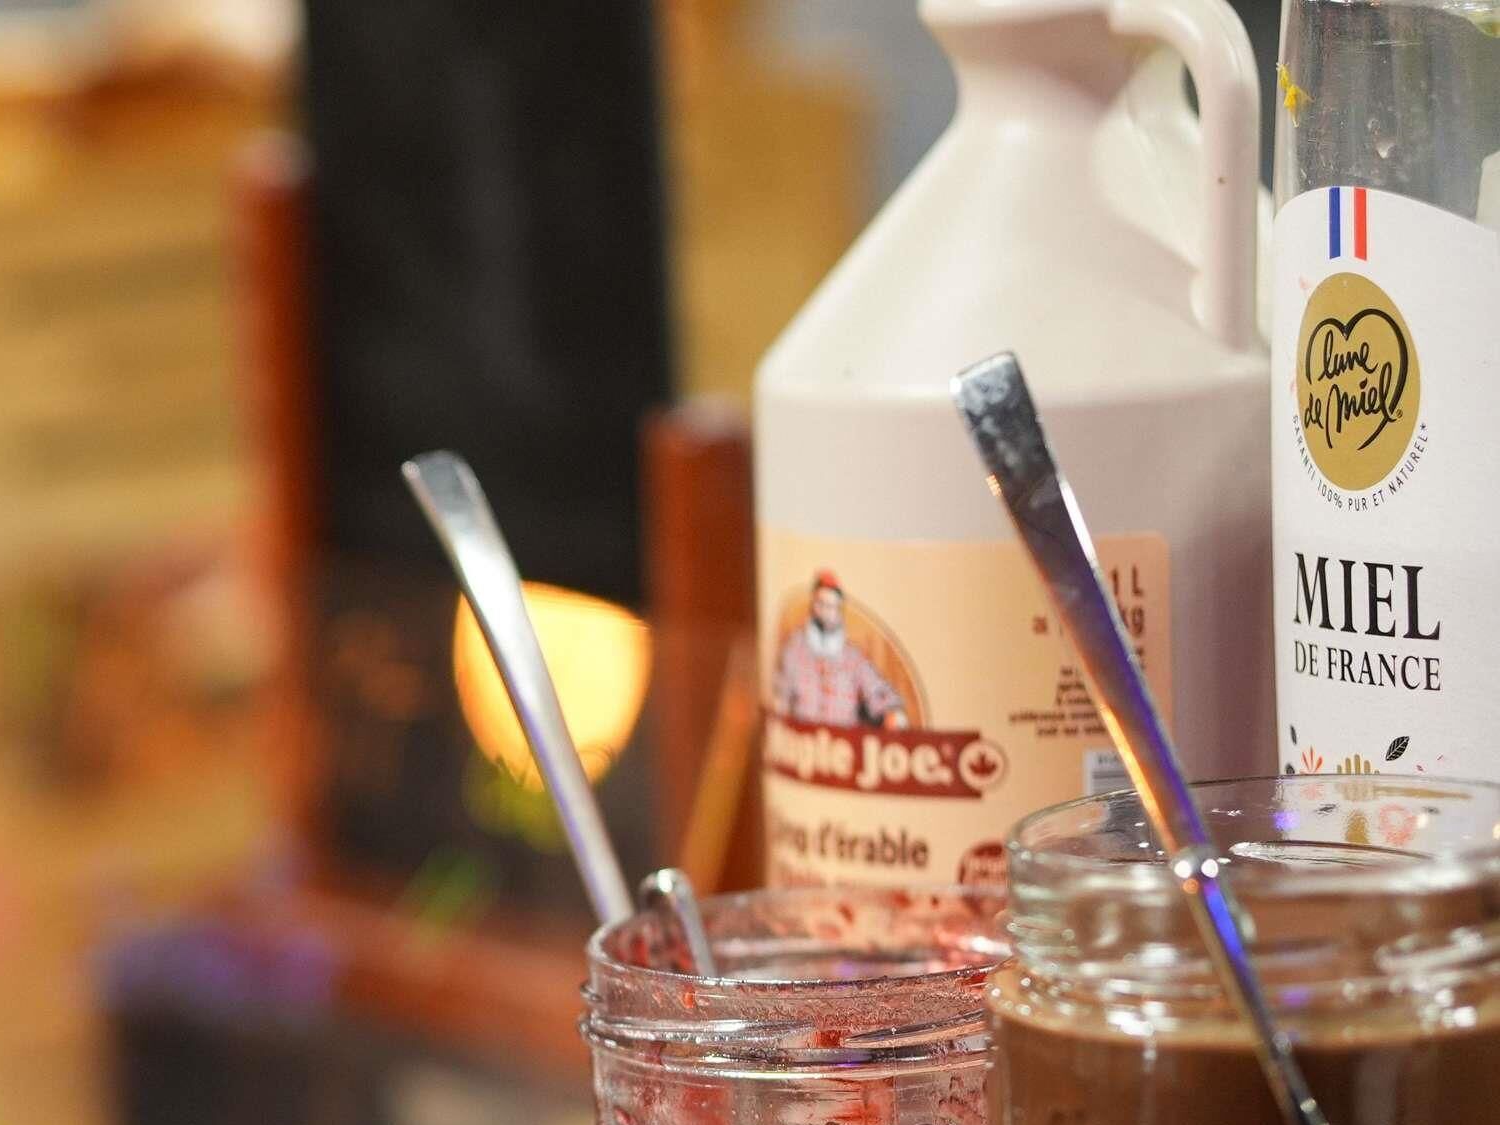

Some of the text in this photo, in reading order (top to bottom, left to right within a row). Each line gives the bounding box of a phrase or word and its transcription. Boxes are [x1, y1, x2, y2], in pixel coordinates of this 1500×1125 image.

[1318, 330, 1379, 382] lune
[1304, 393, 1324, 430] de
[1317, 479, 1344, 510] 100%
[1348, 496, 1369, 512] PUR
[1373, 490, 1386, 506] ET
[1131, 566, 1143, 597] L
[1293, 552, 1442, 641] MIEL
[1294, 640, 1442, 691] DE FRANCE
